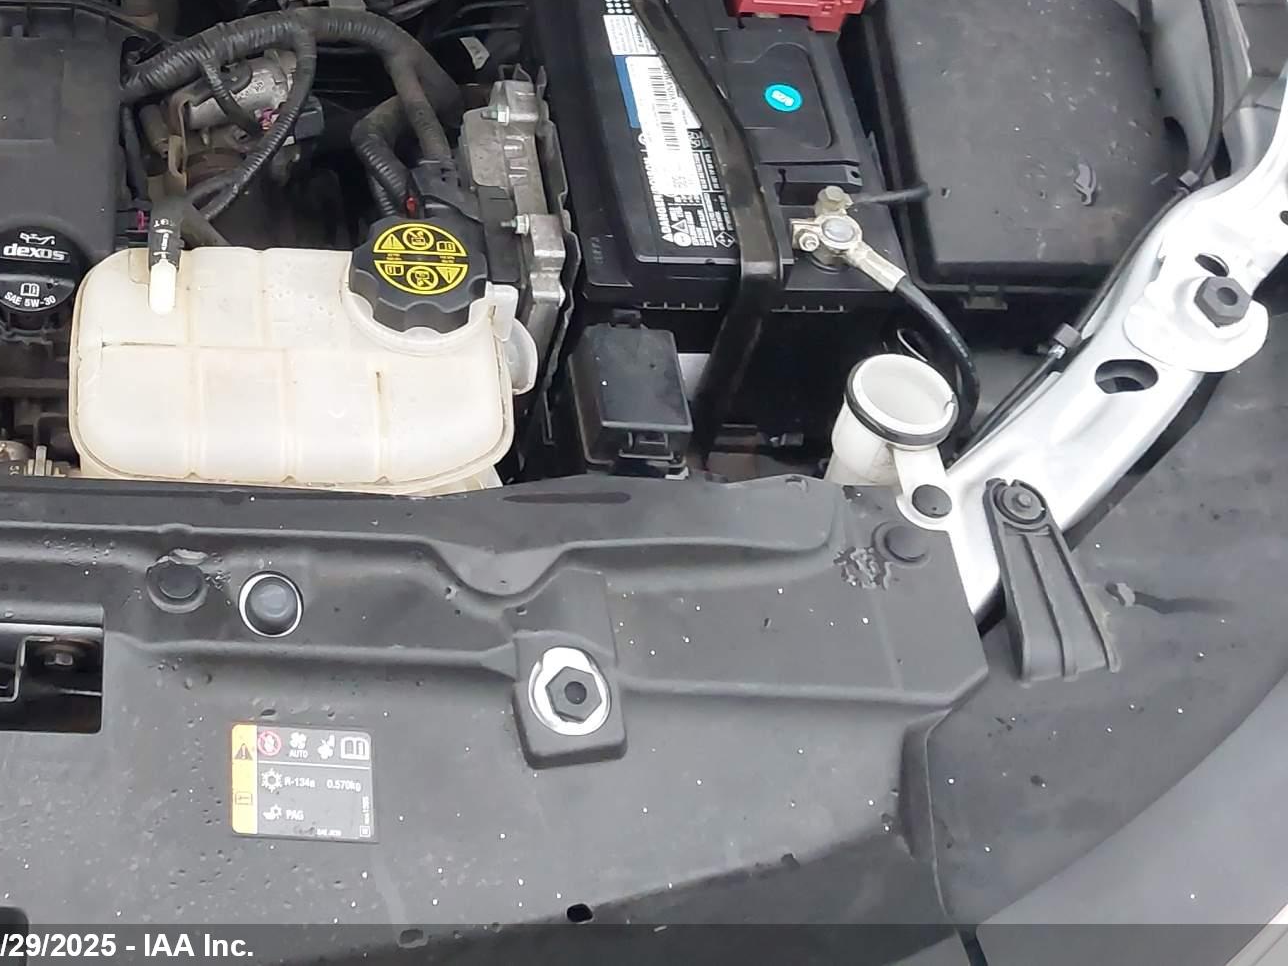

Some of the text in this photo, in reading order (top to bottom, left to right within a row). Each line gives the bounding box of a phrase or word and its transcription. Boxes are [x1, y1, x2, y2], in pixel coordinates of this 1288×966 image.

[3, 243, 69, 261] dexos
[4, 292, 56, 308] SAE 5W-30
[289, 750, 308, 759] AUTO
[285, 809, 304, 821] PAG
